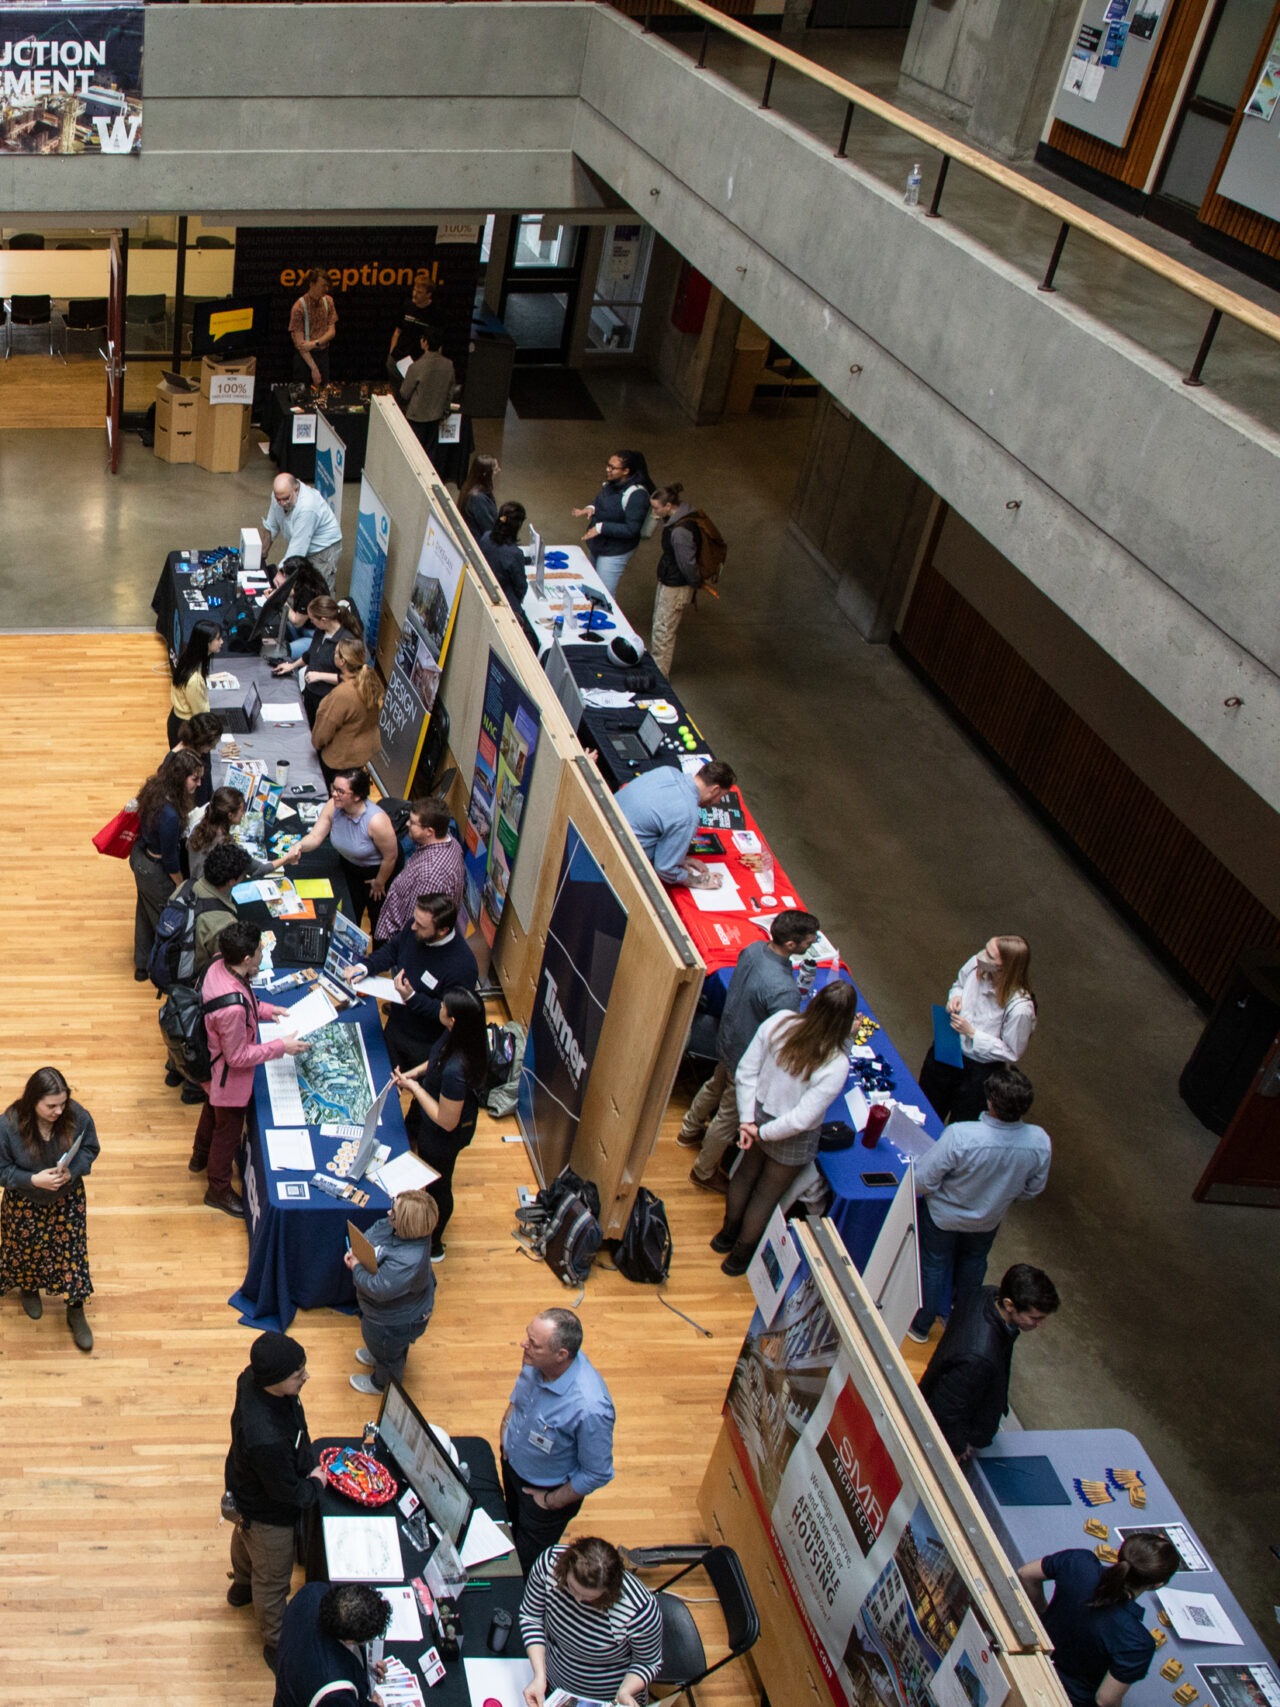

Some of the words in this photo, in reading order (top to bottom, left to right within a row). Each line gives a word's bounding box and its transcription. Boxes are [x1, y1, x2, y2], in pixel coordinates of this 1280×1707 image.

[92, 116, 142, 155] W
[280, 260, 446, 293] exeptional.
[217, 382, 248, 394] 100%
[379, 709, 396, 745] DAY.
[384, 689, 408, 732] EVERY
[389, 670, 418, 723] DESIGN
[543, 967, 588, 1082] Turner
[808, 1471, 820, 1491] We
[816, 1488, 834, 1525] design,
[830, 1522, 853, 1570] preserve,
[832, 1457, 875, 1546] ARCHITECTS
[839, 1435, 884, 1535] SMR
[790, 1503, 834, 1608] HOUSING
[796, 1494, 842, 1593] AFFORDABLE
[806, 1491, 819, 1511] and
[815, 1510, 838, 1555] advocate
[833, 1550, 844, 1570] for
[770, 1527, 834, 1680] www.smrarchitects.com
